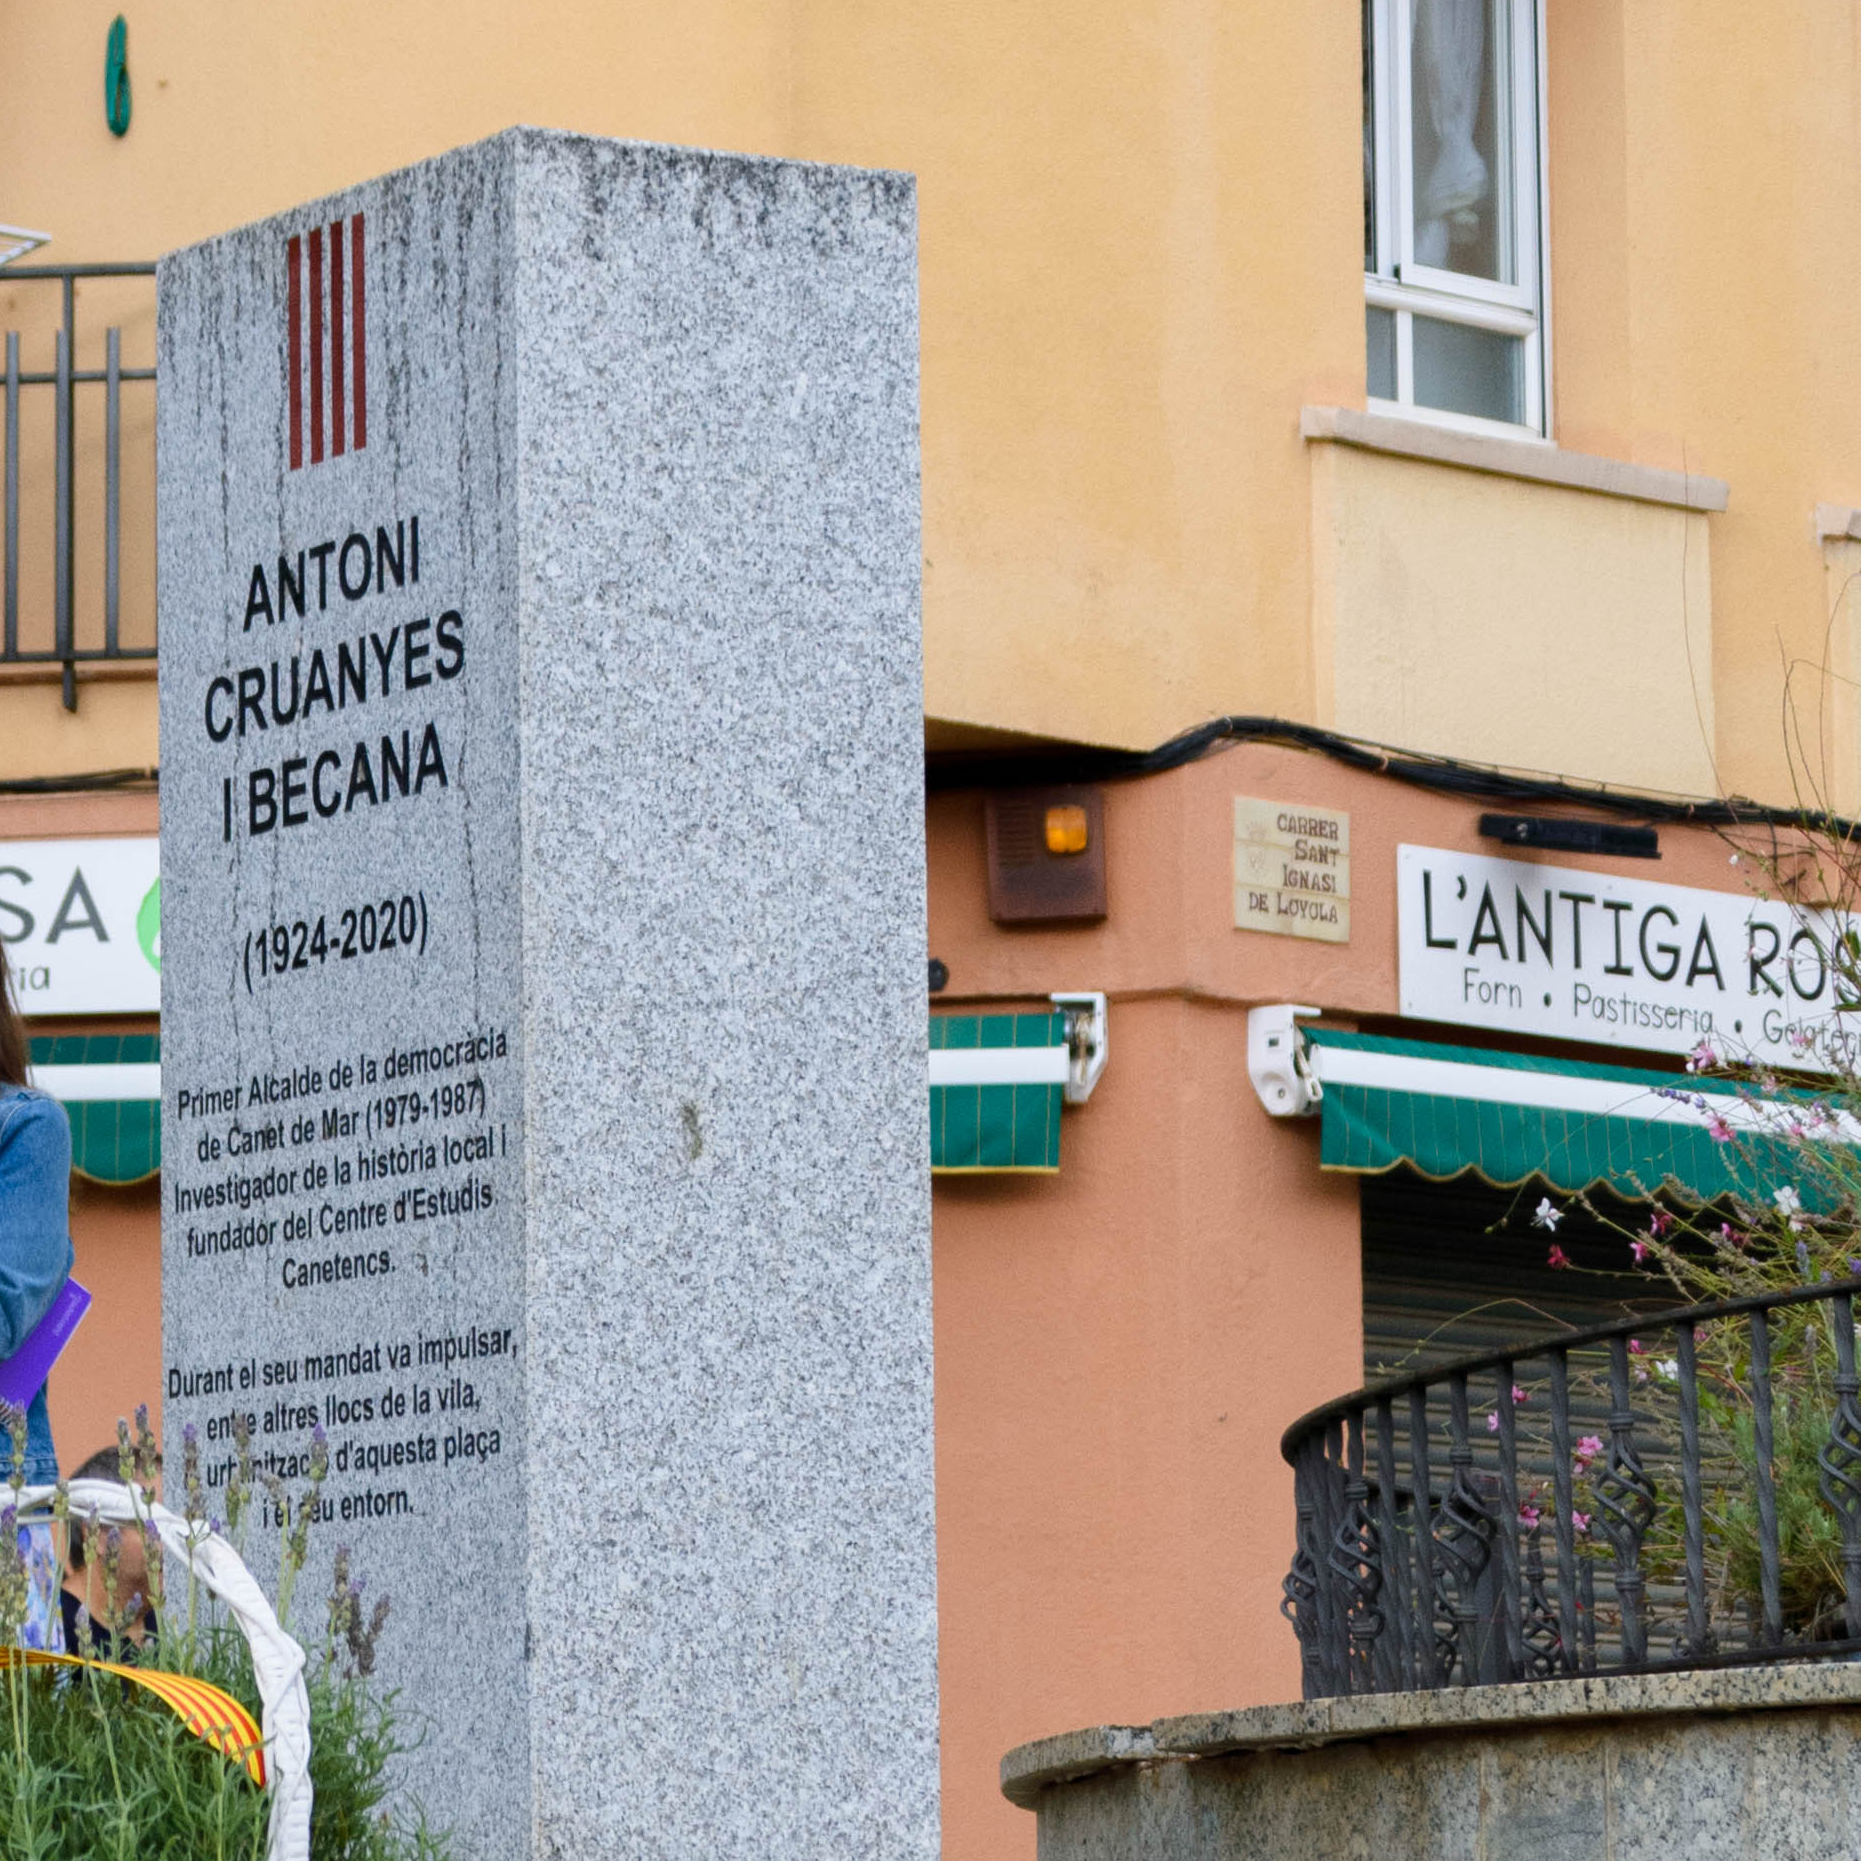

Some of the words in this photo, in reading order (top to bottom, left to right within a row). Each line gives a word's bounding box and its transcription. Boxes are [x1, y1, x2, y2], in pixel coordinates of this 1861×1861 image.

[243, 515, 419, 633] ANTONI
[205, 610, 464, 743] CRUANYES
[223, 776, 232, 843] I
[249, 721, 448, 836] BECANA
[1277, 813, 1339, 841] CARRER
[244, 890, 428, 996] (1924-2020)
[1423, 869, 1726, 991] L'ANTIGA
[1464, 968, 1522, 1009] Forn
[1573, 983, 1714, 1034] Pastisseria
[178, 1087, 242, 1121] Primer
[248, 1065, 322, 1107] Alcalde
[329, 1058, 353, 1090] de
[360, 1054, 377, 1085] la
[384, 1027, 507, 1080] democràcia
[197, 1132, 221, 1163] de
[227, 1119, 285, 1157] Canet
[291, 1114, 315, 1146] de
[322, 1106, 359, 1140] Mar
[366, 1077, 486, 1140] (1979-1987)
[174, 1166, 297, 1214] Investigador
[303, 1159, 327, 1190] de
[334, 1154, 351, 1185] la
[358, 1140, 436, 1181] història
[444, 1126, 494, 1167] local
[501, 1123, 506, 1157] i
[187, 1217, 278, 1258] fundador
[283, 1208, 312, 1242] del
[319, 1201, 387, 1236] Centre
[394, 1177, 493, 1224] d'Estudis
[282, 1250, 396, 1288] Canetencs.
[168, 1363, 233, 1399] Durant
[240, 1358, 256, 1389] el
[263, 1360, 297, 1387] seu
[305, 1341, 381, 1381] mandat
[387, 1344, 411, 1370] va
[418, 1326, 518, 1370] impulsar,
[207, 1408, 257, 1440] ente
[263, 1400, 319, 1434] altres
[325, 1394, 374, 1427] llocs
[381, 1386, 405, 1419] de
[413, 1383, 430, 1415] la
[438, 1377, 481, 1413] vila,
[336, 1432, 436, 1476] d'aquesta
[444, 1426, 501, 1467] plaça
[263, 1498, 268, 1529] i
[340, 1489, 414, 1520] entorn.
